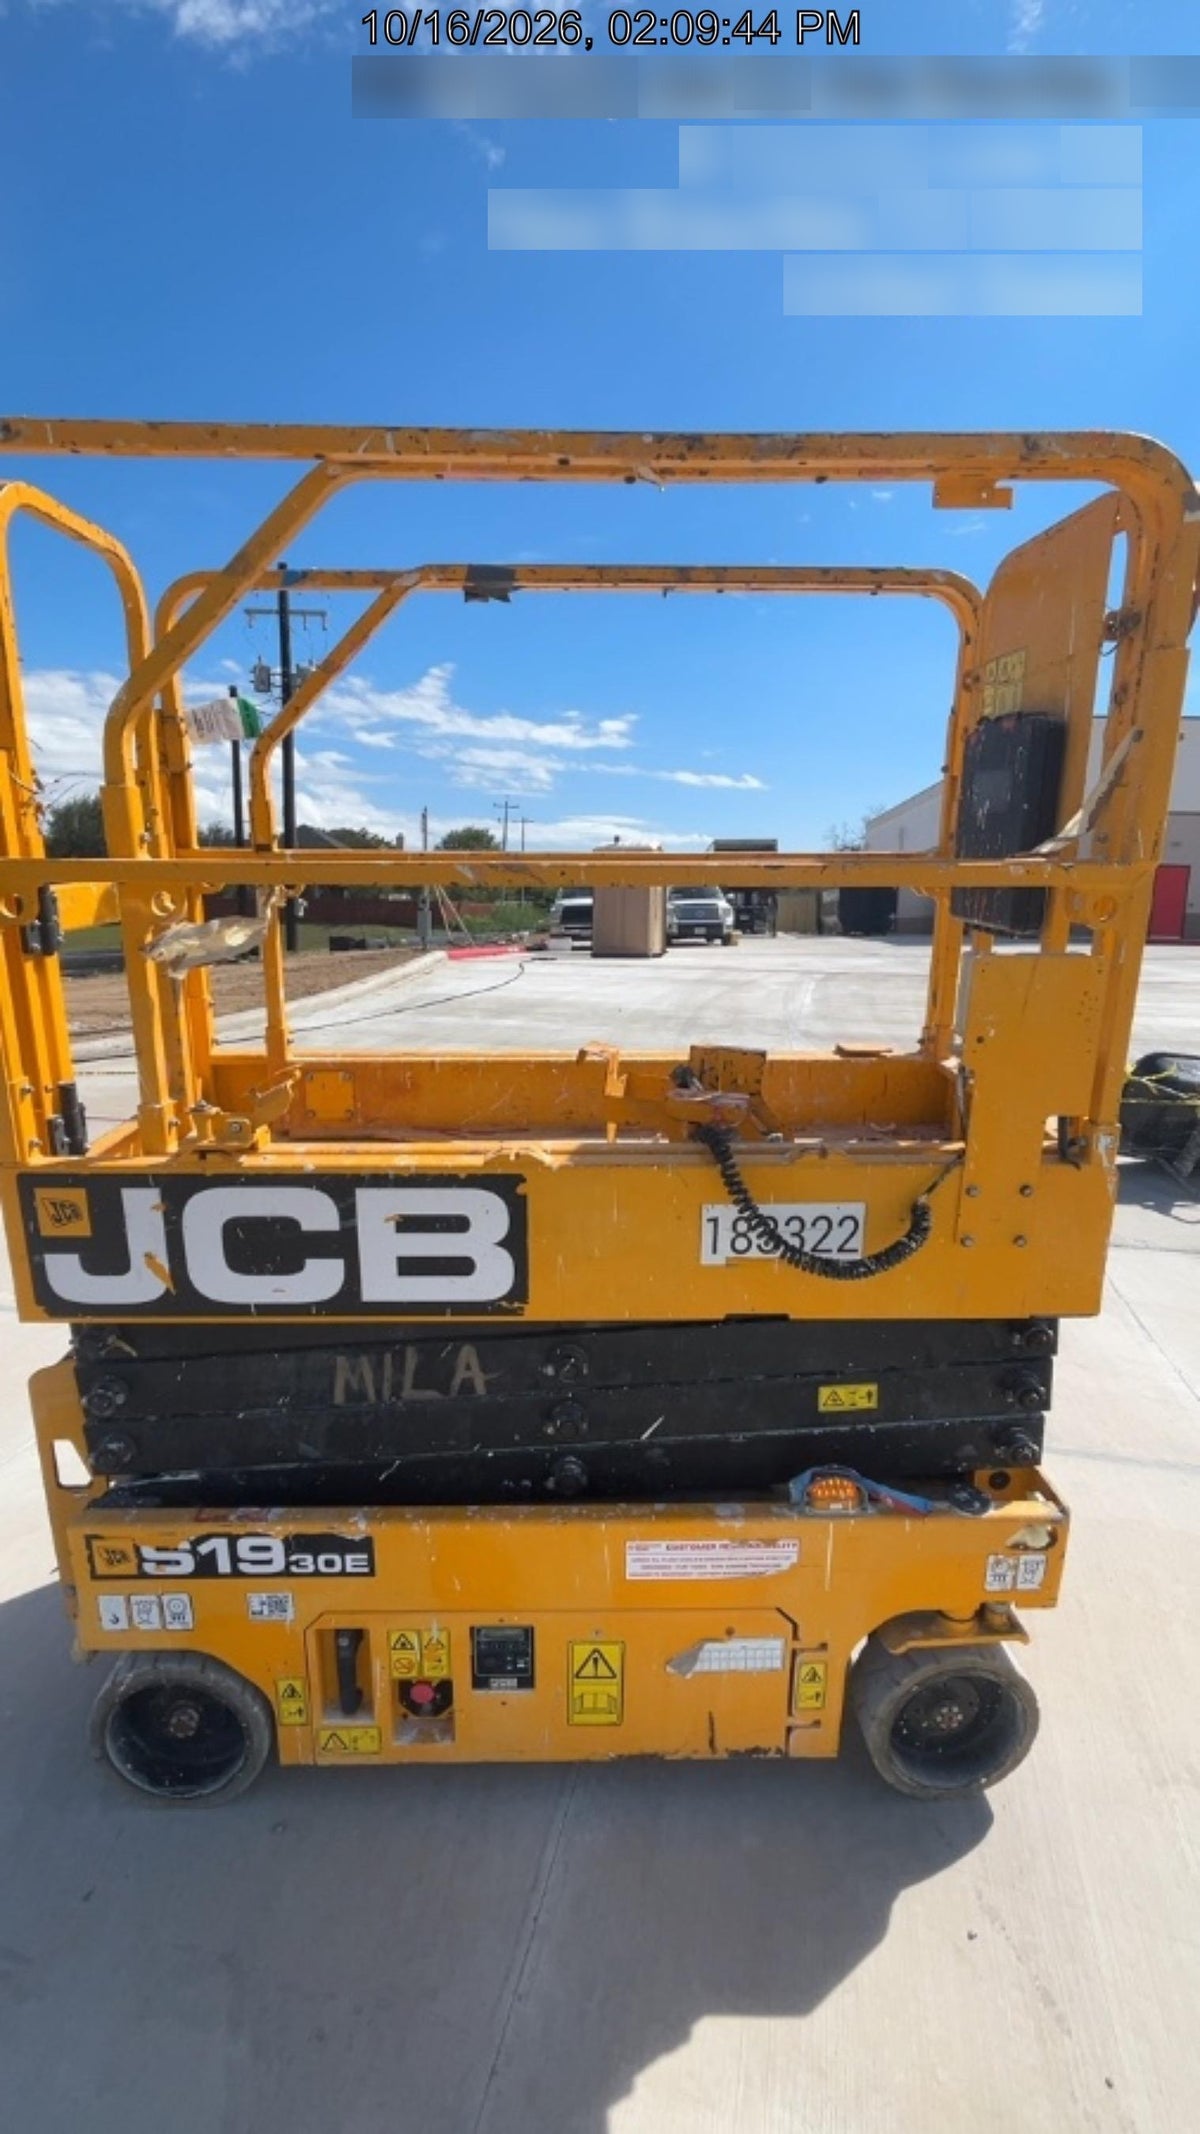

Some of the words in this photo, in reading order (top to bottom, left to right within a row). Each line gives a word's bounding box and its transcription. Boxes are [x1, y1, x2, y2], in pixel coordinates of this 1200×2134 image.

[44, 1187, 516, 1304] JCB
[706, 1214, 860, 1255] 183322
[333, 1343, 488, 1405] MILA
